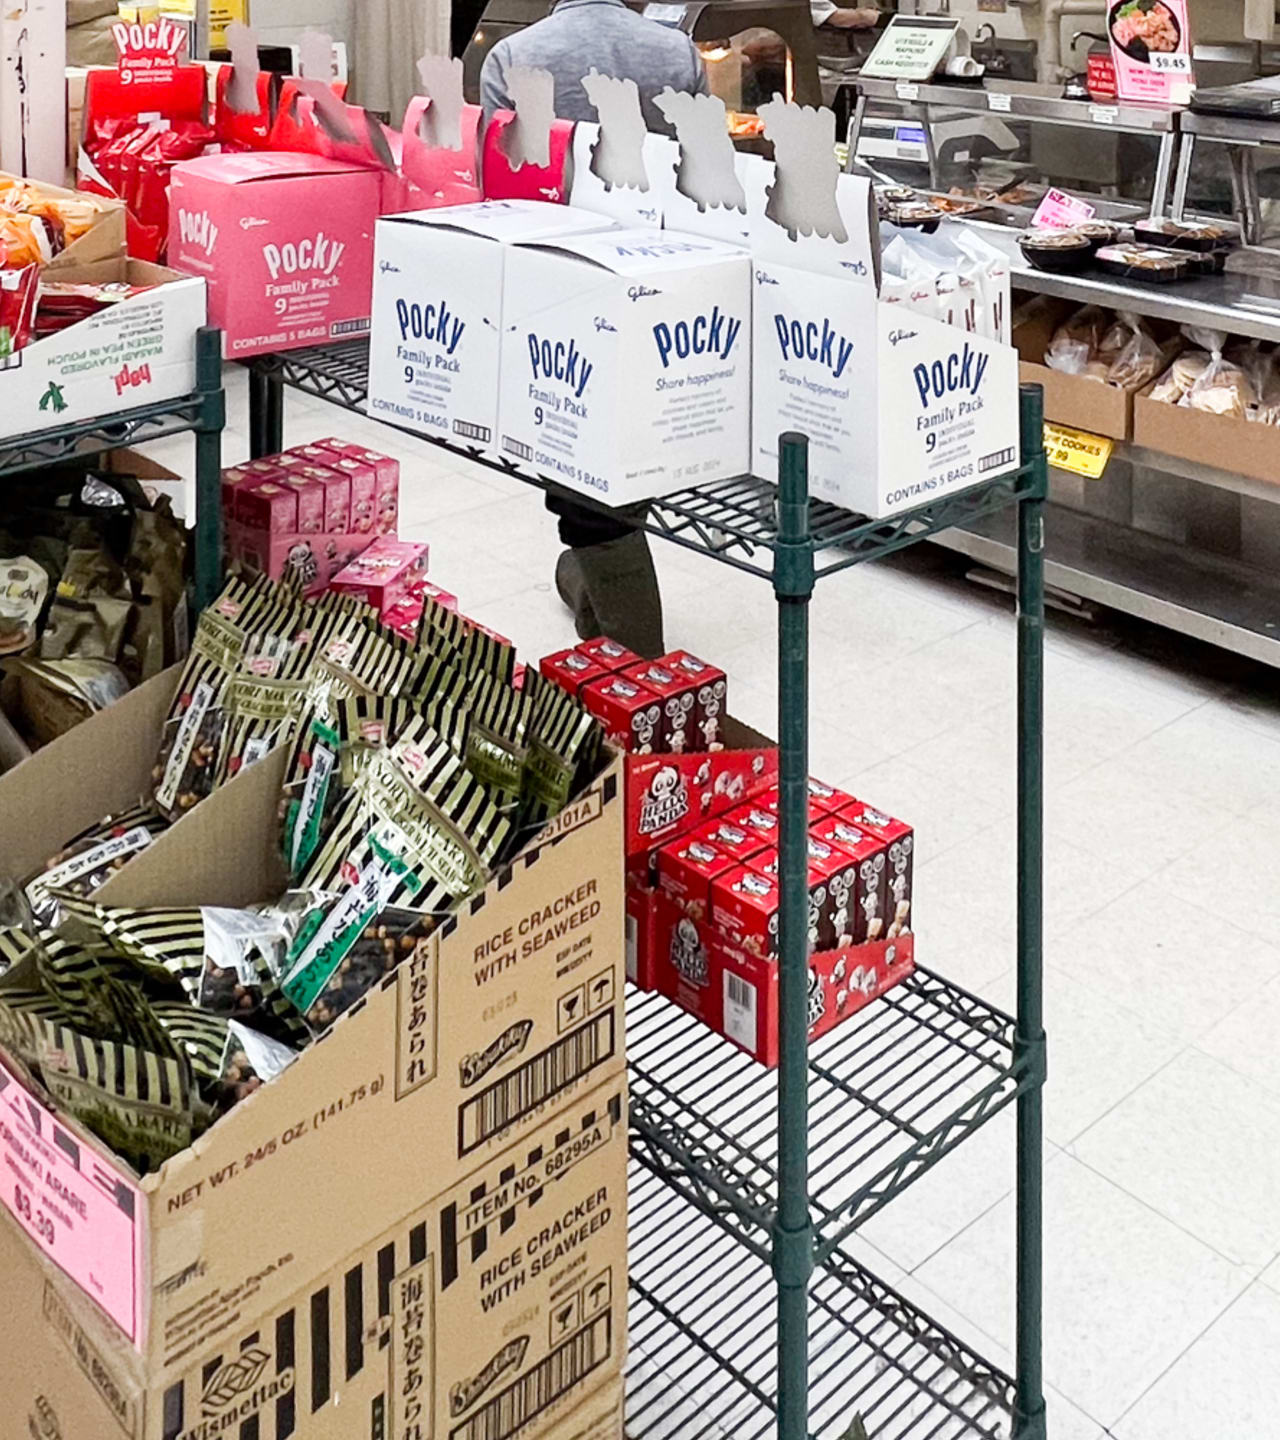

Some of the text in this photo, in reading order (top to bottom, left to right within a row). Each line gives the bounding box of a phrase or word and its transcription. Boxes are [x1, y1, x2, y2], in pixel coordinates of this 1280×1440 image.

[121, 69, 133, 85] 9
[265, 275, 340, 297] Family Pack
[628, 285, 662, 302] Glico
[274, 298, 287, 314] 9
[47, 334, 163, 366] GREEN PEA IN POUCH
[232, 326, 326, 350] CONTAINS 5 BAGS
[888, 329, 919, 346] Glico
[60, 356, 119, 375] FLAVORED
[397, 345, 460, 373] Family Pack
[404, 366, 414, 383] 9
[656, 366, 735, 391] Share happiness!
[779, 368, 802, 387] Share
[372, 398, 449, 429] CONTAINS 5 BAGS
[529, 384, 588, 418] Family Pack
[534, 406, 543, 425] 9
[917, 396, 984, 431] Family Pack
[925, 432, 937, 454] 9
[535, 450, 609, 492] CONTAINS 5 BAGS
[886, 464, 974, 505] CONTAINS 5 BAGS
[372, 760, 404, 803] NORI
[639, 804, 689, 835] PANDA
[641, 789, 689, 820] HELLO
[473, 879, 598, 963] RICE CRACKER
[473, 950, 517, 987] WITH
[521, 900, 601, 959] SEAWEED
[167, 1181, 205, 1214] NET
[209, 1161, 240, 1190] WT.
[243, 1139, 278, 1169] 24/5
[312, 1084, 368, 1131] (141.75
[369, 1072, 385, 1100] g)
[465, 1127, 603, 1231] ITEM No. 68295A
[479, 1185, 608, 1292] RICE CRACKER
[480, 1207, 612, 1314] WITH SEAWEED
